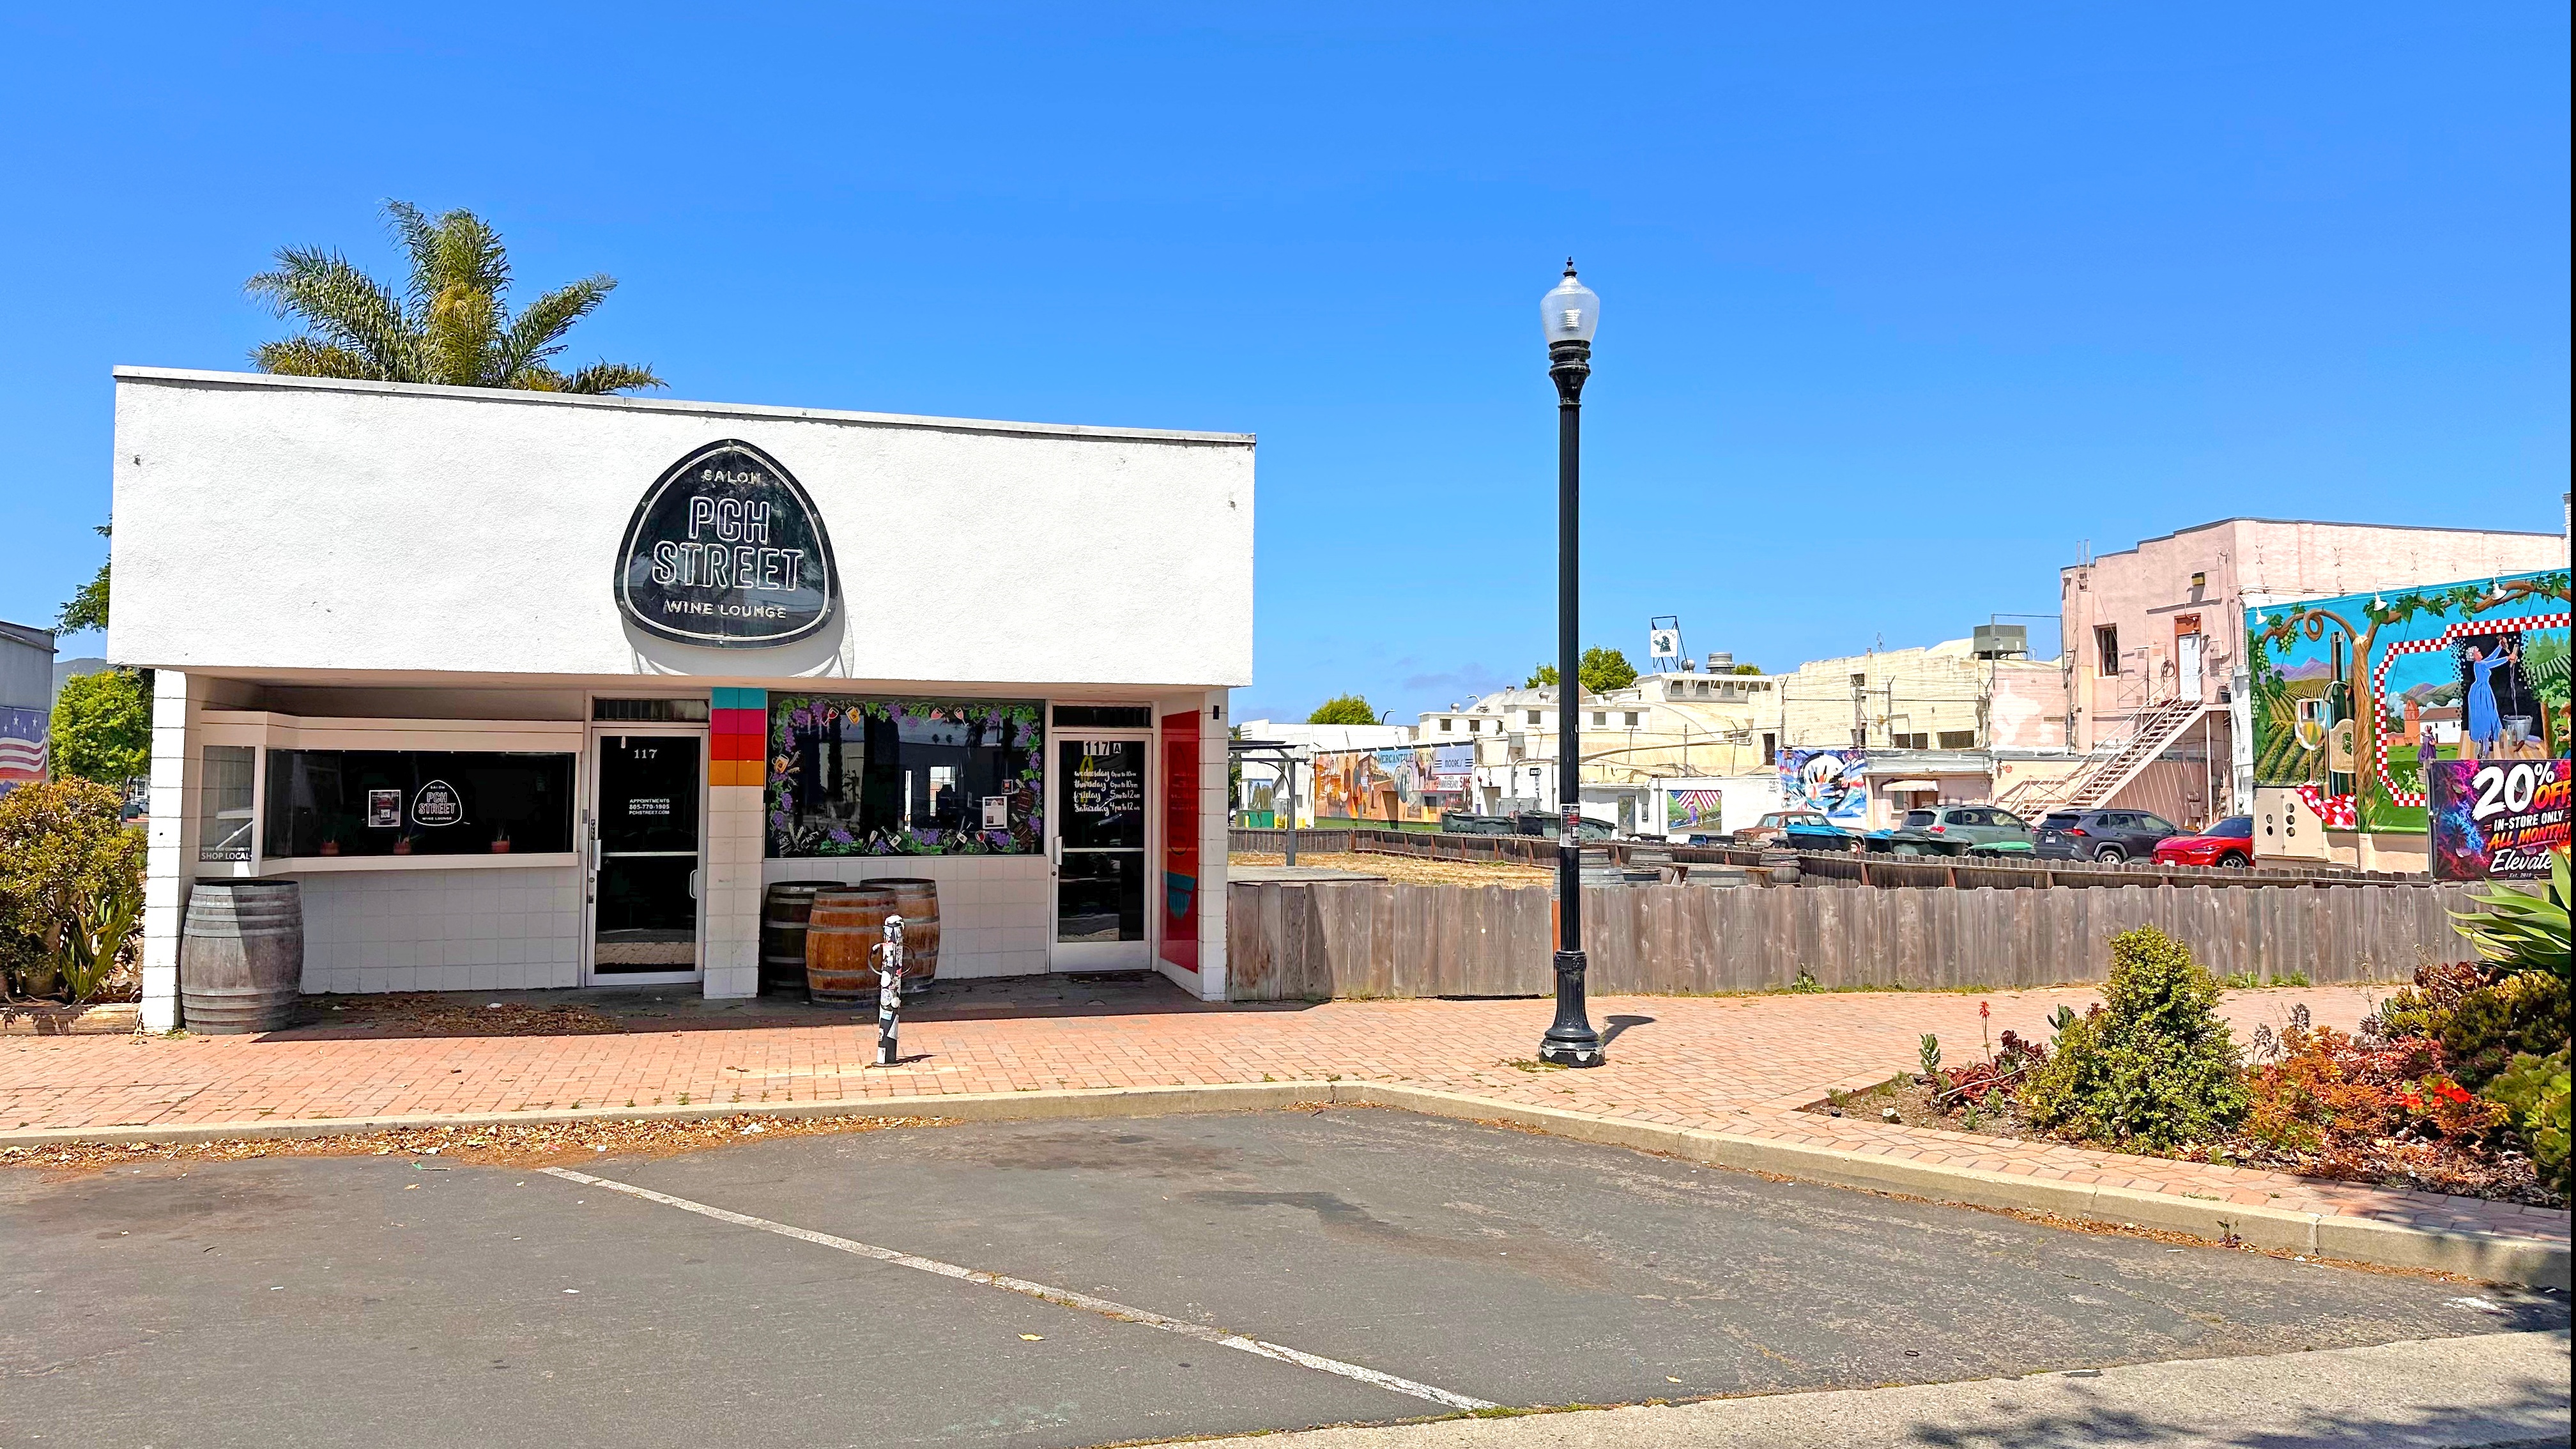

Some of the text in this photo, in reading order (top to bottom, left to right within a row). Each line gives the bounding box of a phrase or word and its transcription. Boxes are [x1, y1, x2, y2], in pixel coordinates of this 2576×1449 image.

[701, 469, 761, 484] SALON
[689, 496, 770, 544] PCH
[652, 540, 804, 592] STREET
[664, 599, 786, 618] WINE LOUNGE
[634, 749, 657, 759] 117
[1085, 741, 1120, 755] 117 A
[1377, 751, 1434, 765] MERCANTILE UNION
[1110, 780, 1121, 789] 6pm
[2471, 762, 2555, 821] 20%
[426, 792, 447, 803] PCH
[418, 802, 456, 814] STREET
[2494, 810, 2564, 831] IN-STORE ONLY
[2486, 822, 2571, 852] ALL MONTH!
[2490, 848, 2552, 873] Elevate
